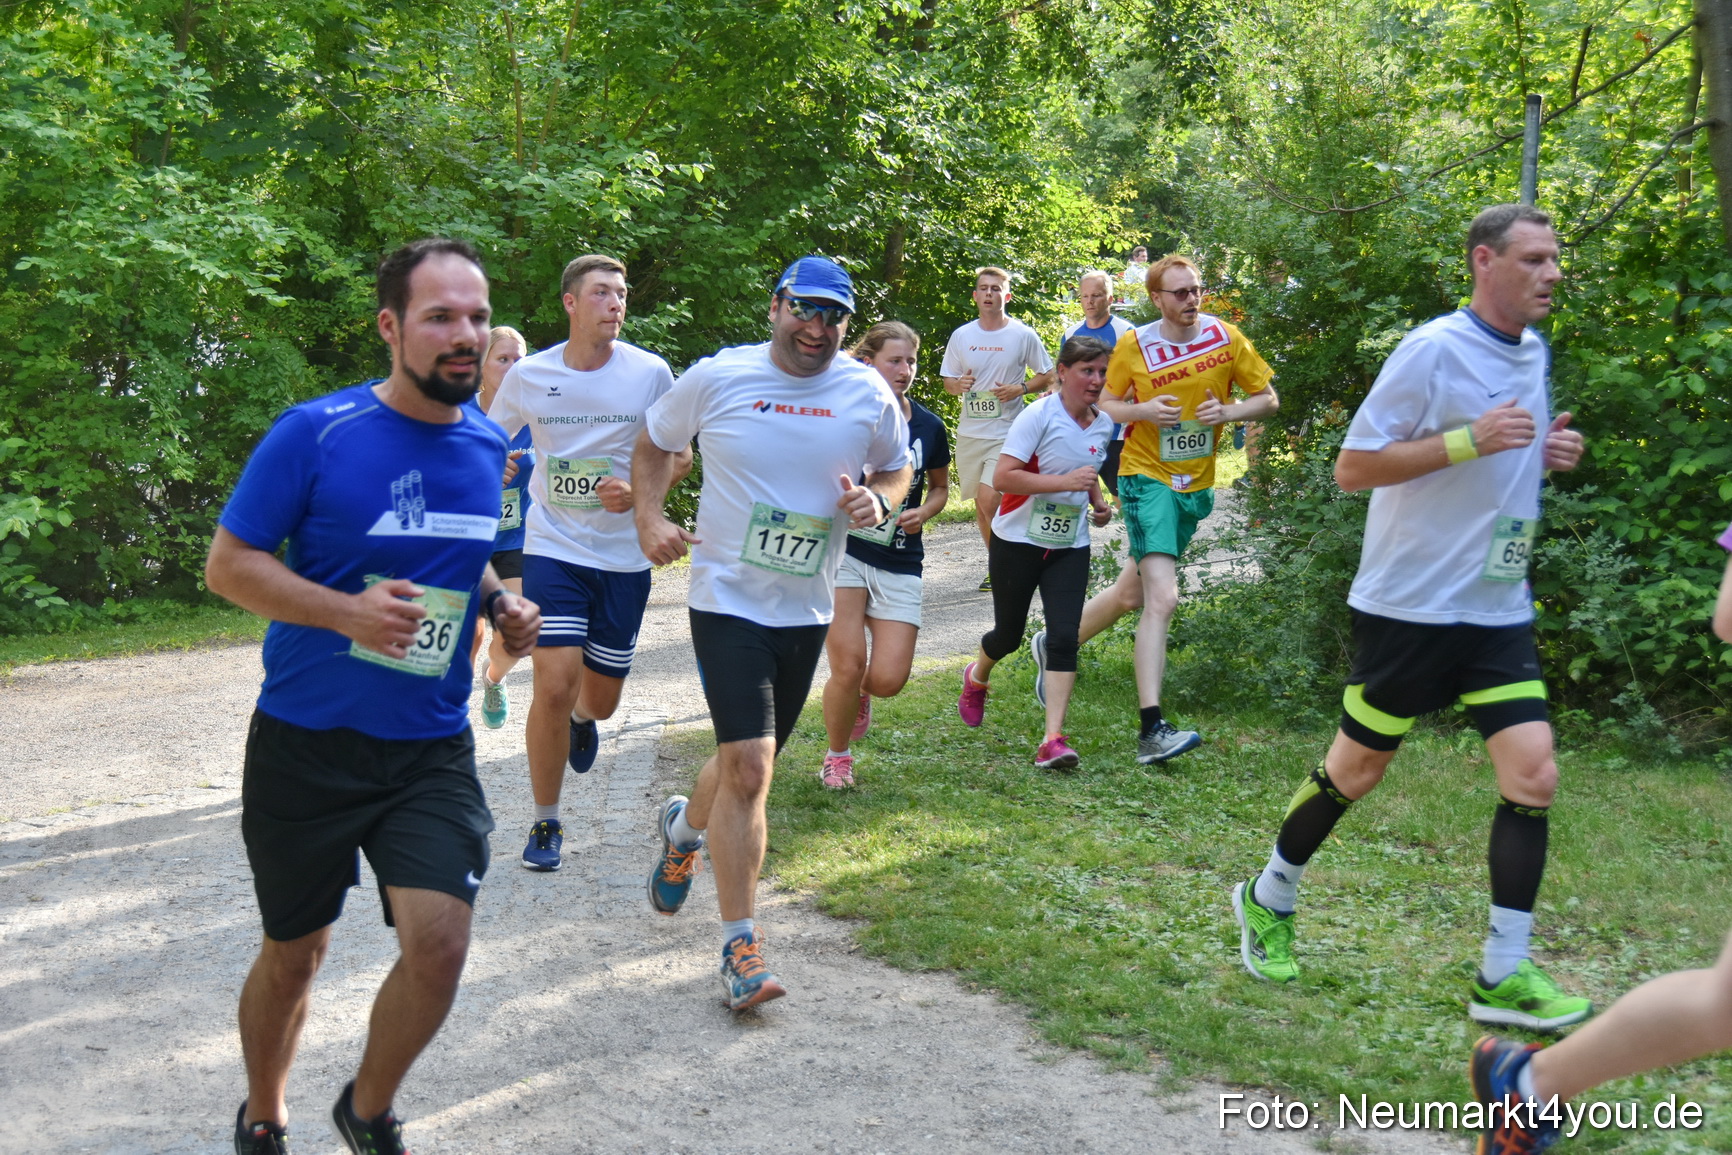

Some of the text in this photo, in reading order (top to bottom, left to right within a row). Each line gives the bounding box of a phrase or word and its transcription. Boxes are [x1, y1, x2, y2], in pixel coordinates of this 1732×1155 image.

[1151, 350, 1234, 389] MAX BÖGL
[775, 403, 837, 418] KLEBL
[969, 401, 995, 411] 1188
[537, 414, 637, 425] RUPPRECHT HOLZBAU
[1166, 433, 1206, 450] 1660
[1041, 516, 1071, 533] 355
[758, 529, 819, 560] 1177
